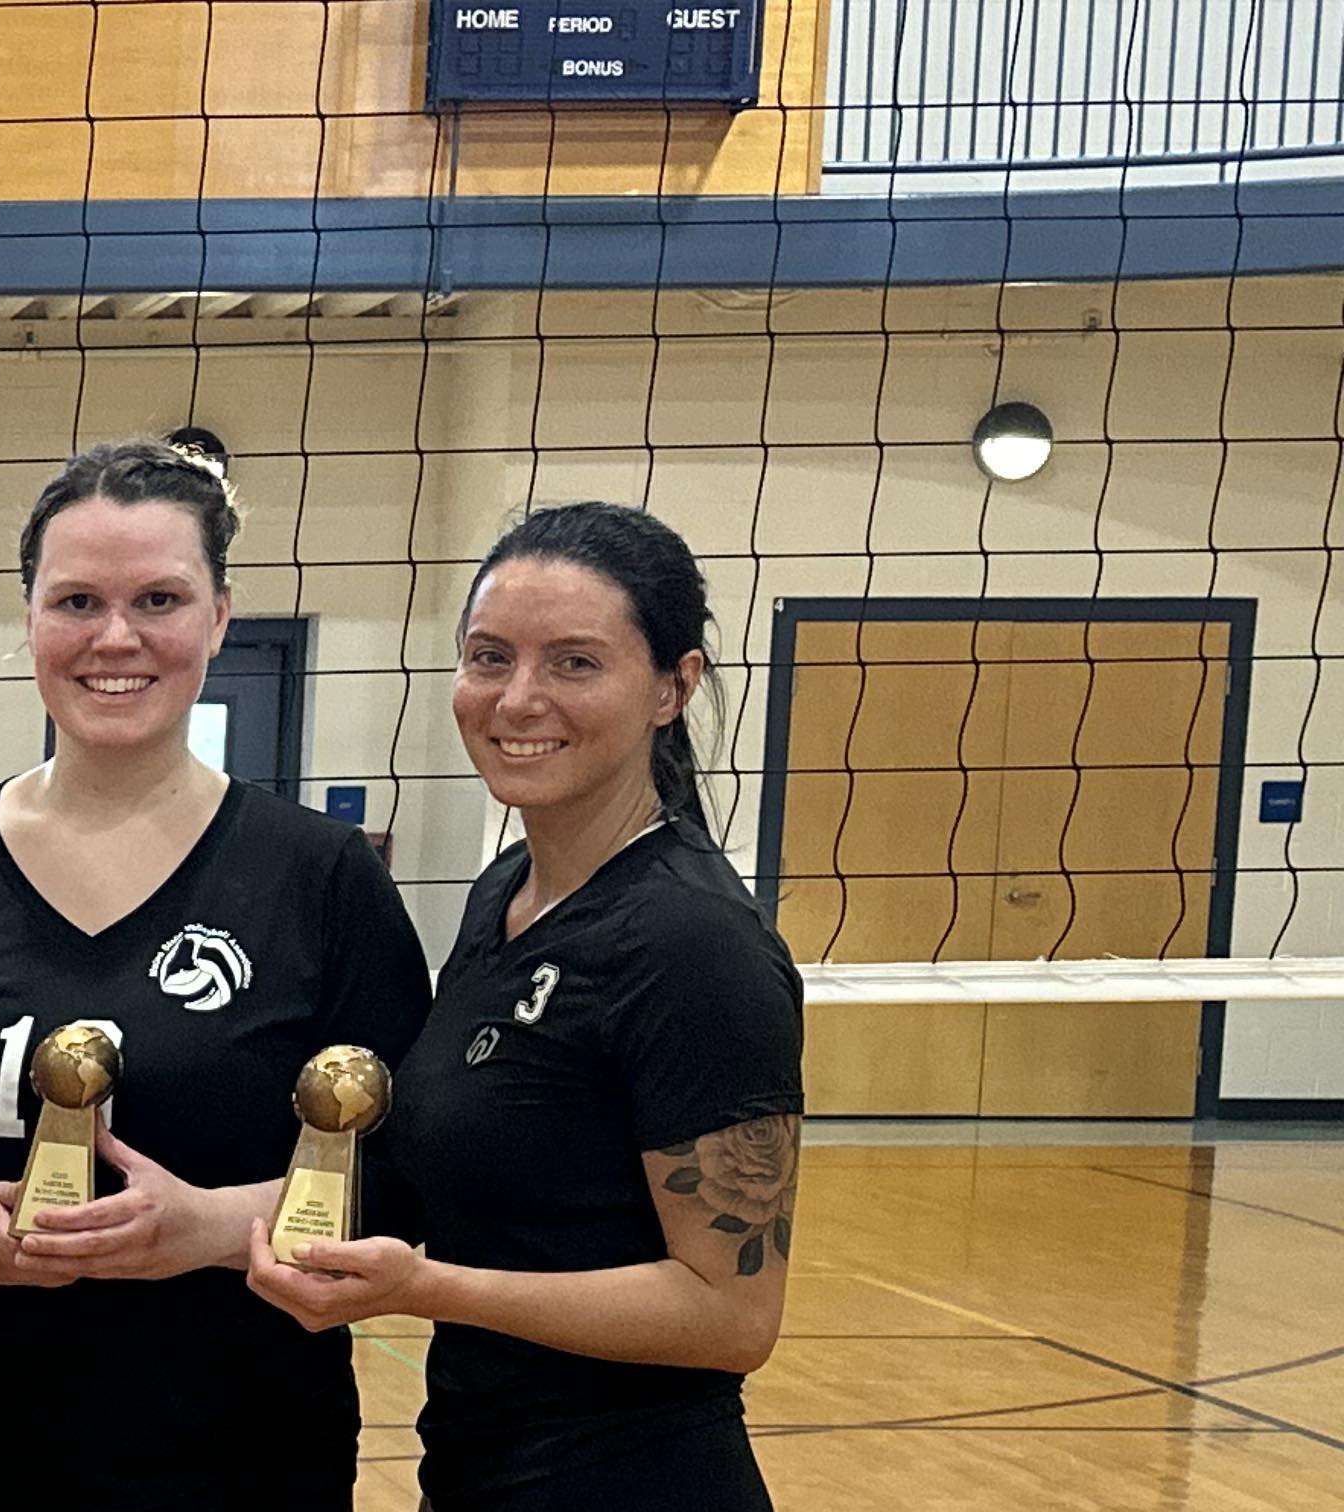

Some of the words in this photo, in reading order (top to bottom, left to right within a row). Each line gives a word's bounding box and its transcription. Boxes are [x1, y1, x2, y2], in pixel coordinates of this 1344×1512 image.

[456, 9, 520, 29] HOME
[548, 16, 613, 33] PERIOD
[666, 8, 741, 29] GUEST
[562, 59, 624, 77] BONUS
[514, 962, 560, 1024] 3
